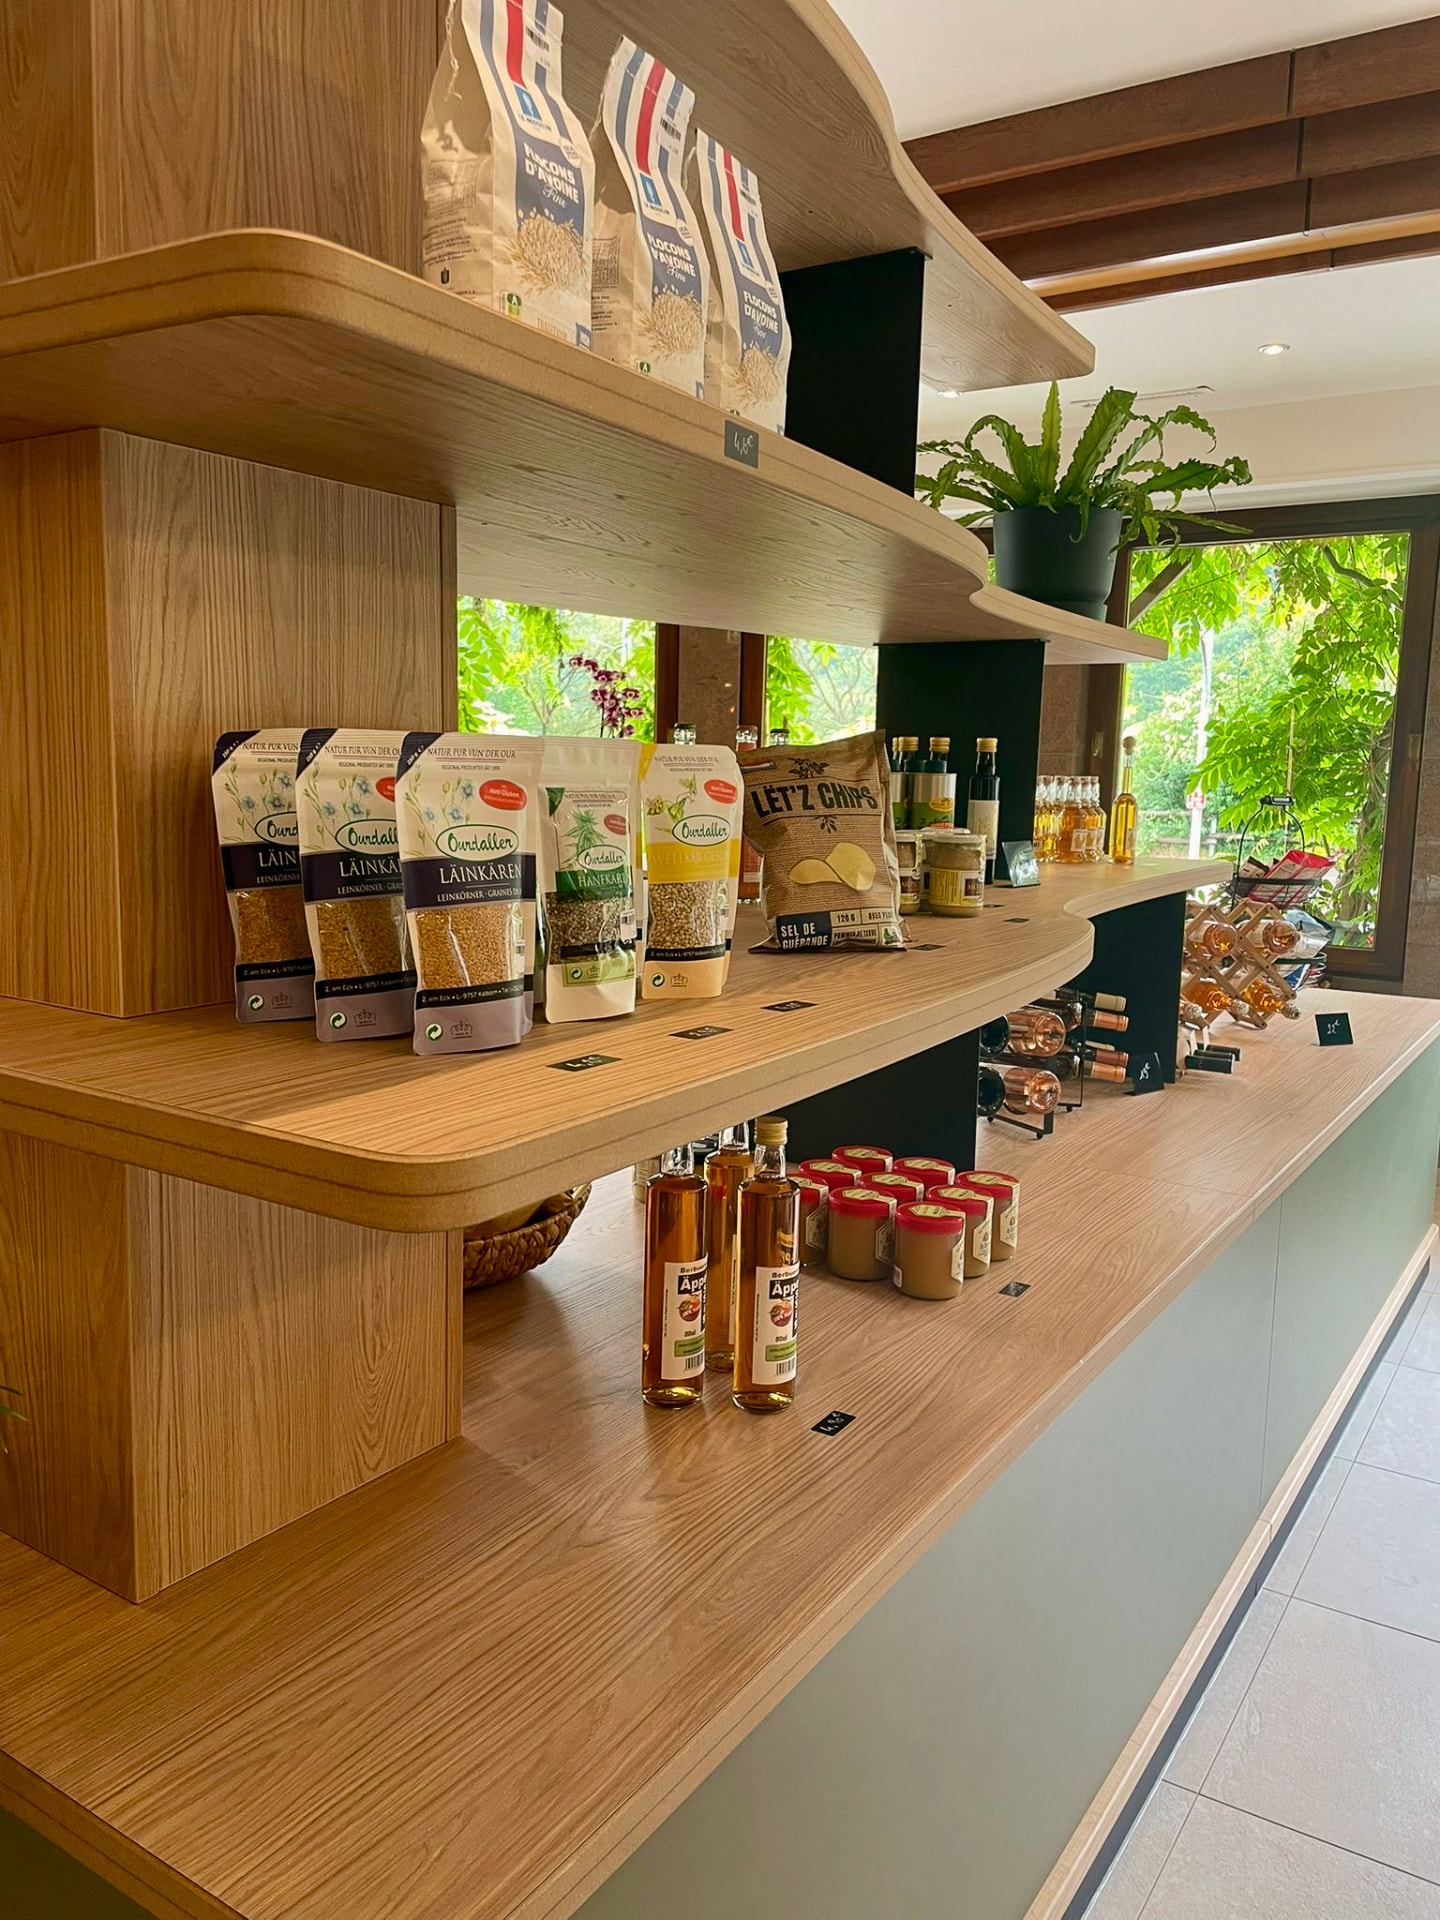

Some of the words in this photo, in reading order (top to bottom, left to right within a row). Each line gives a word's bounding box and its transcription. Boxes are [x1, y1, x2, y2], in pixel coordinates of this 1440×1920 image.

[646, 232, 691, 261] FLOCONS
[742, 290, 777, 319] FLOCONS
[242, 743, 266, 751] NATUR
[268, 743, 282, 751] PUR
[283, 743, 299, 751] VUN
[325, 746, 346, 754] NATUR
[348, 746, 362, 755] PUR
[363, 747, 376, 755] VUN
[378, 747, 391, 755] DER
[428, 748, 451, 756] NATUR
[453, 748, 467, 756] PUR
[469, 749, 483, 757] VUN
[486, 749, 499, 758] DER
[501, 750, 516, 758] OUR
[817, 782, 879, 810] CHIPS
[682, 822, 728, 839] Ourdaller
[447, 832, 513, 853] Ourdaller
[440, 862, 522, 884] LÄINKÄREN
[437, 890, 485, 902] LEINKÖRNER
[837, 914, 849, 923] 120
[780, 923, 800, 938] SEL
[803, 922, 816, 935] DE
